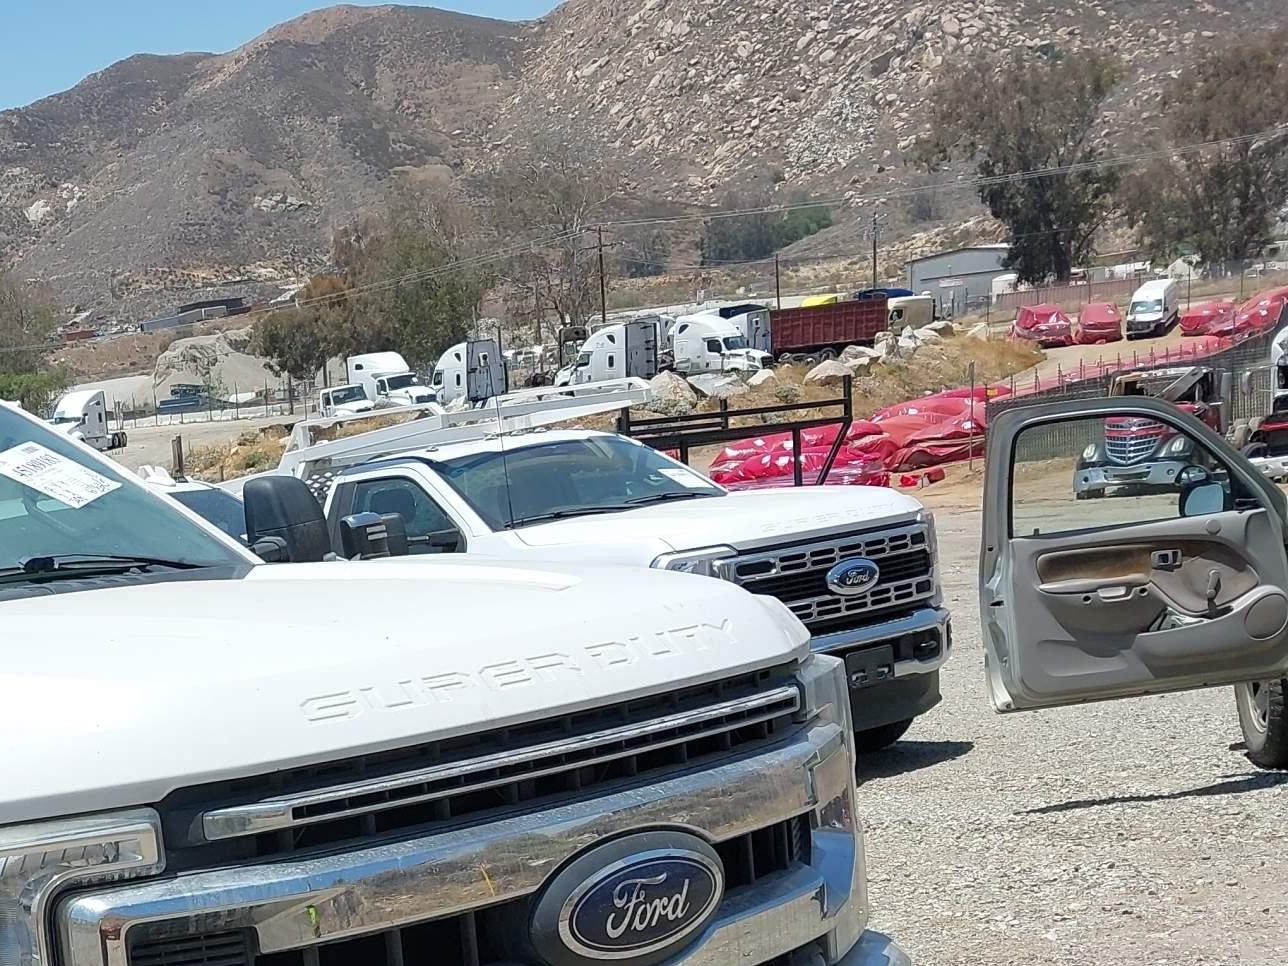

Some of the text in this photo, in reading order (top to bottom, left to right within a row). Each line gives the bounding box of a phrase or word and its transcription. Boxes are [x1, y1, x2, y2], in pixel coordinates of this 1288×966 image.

[845, 569, 871, 586] Ford
[298, 617, 738, 724] SUPER DUTY
[606, 872, 690, 939] Ford
